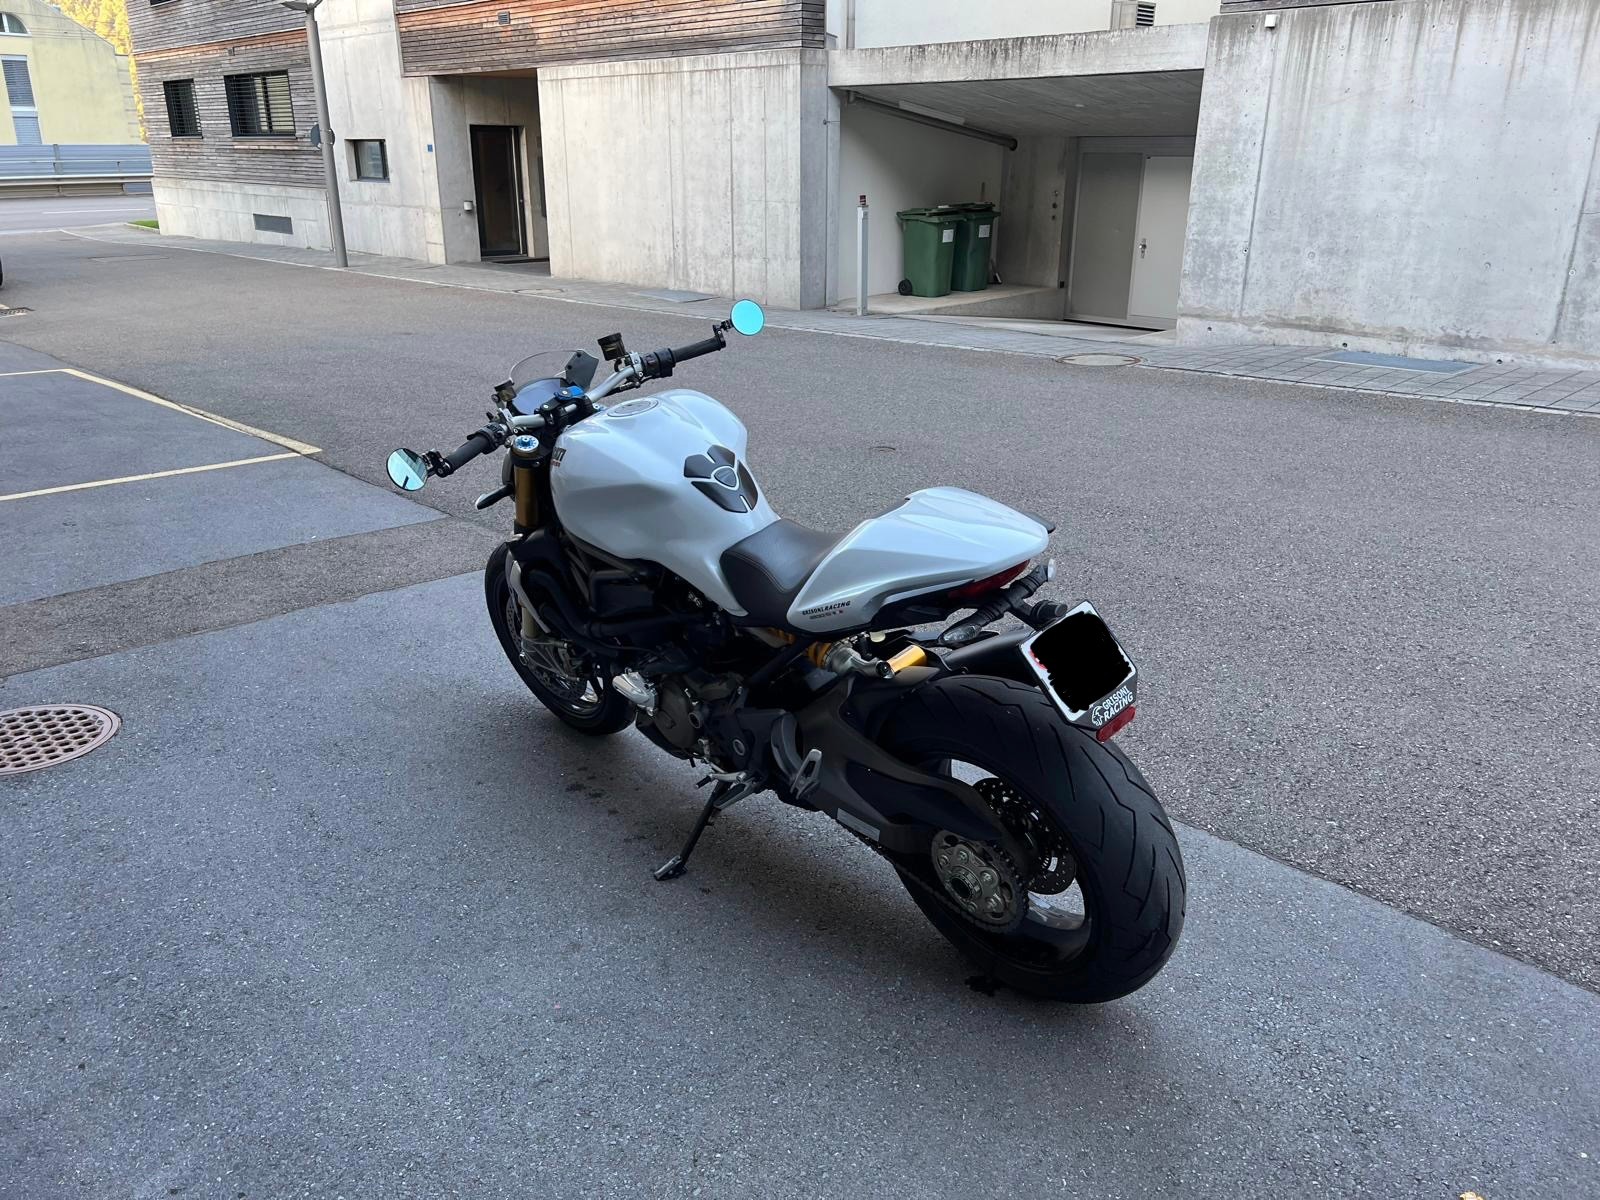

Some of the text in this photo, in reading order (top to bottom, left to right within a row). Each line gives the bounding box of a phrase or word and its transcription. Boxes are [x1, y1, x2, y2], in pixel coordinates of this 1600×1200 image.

[824, 600, 851, 611] RACING
[1102, 685, 1130, 710] GRISONI
[1103, 692, 1134, 722] RACING
